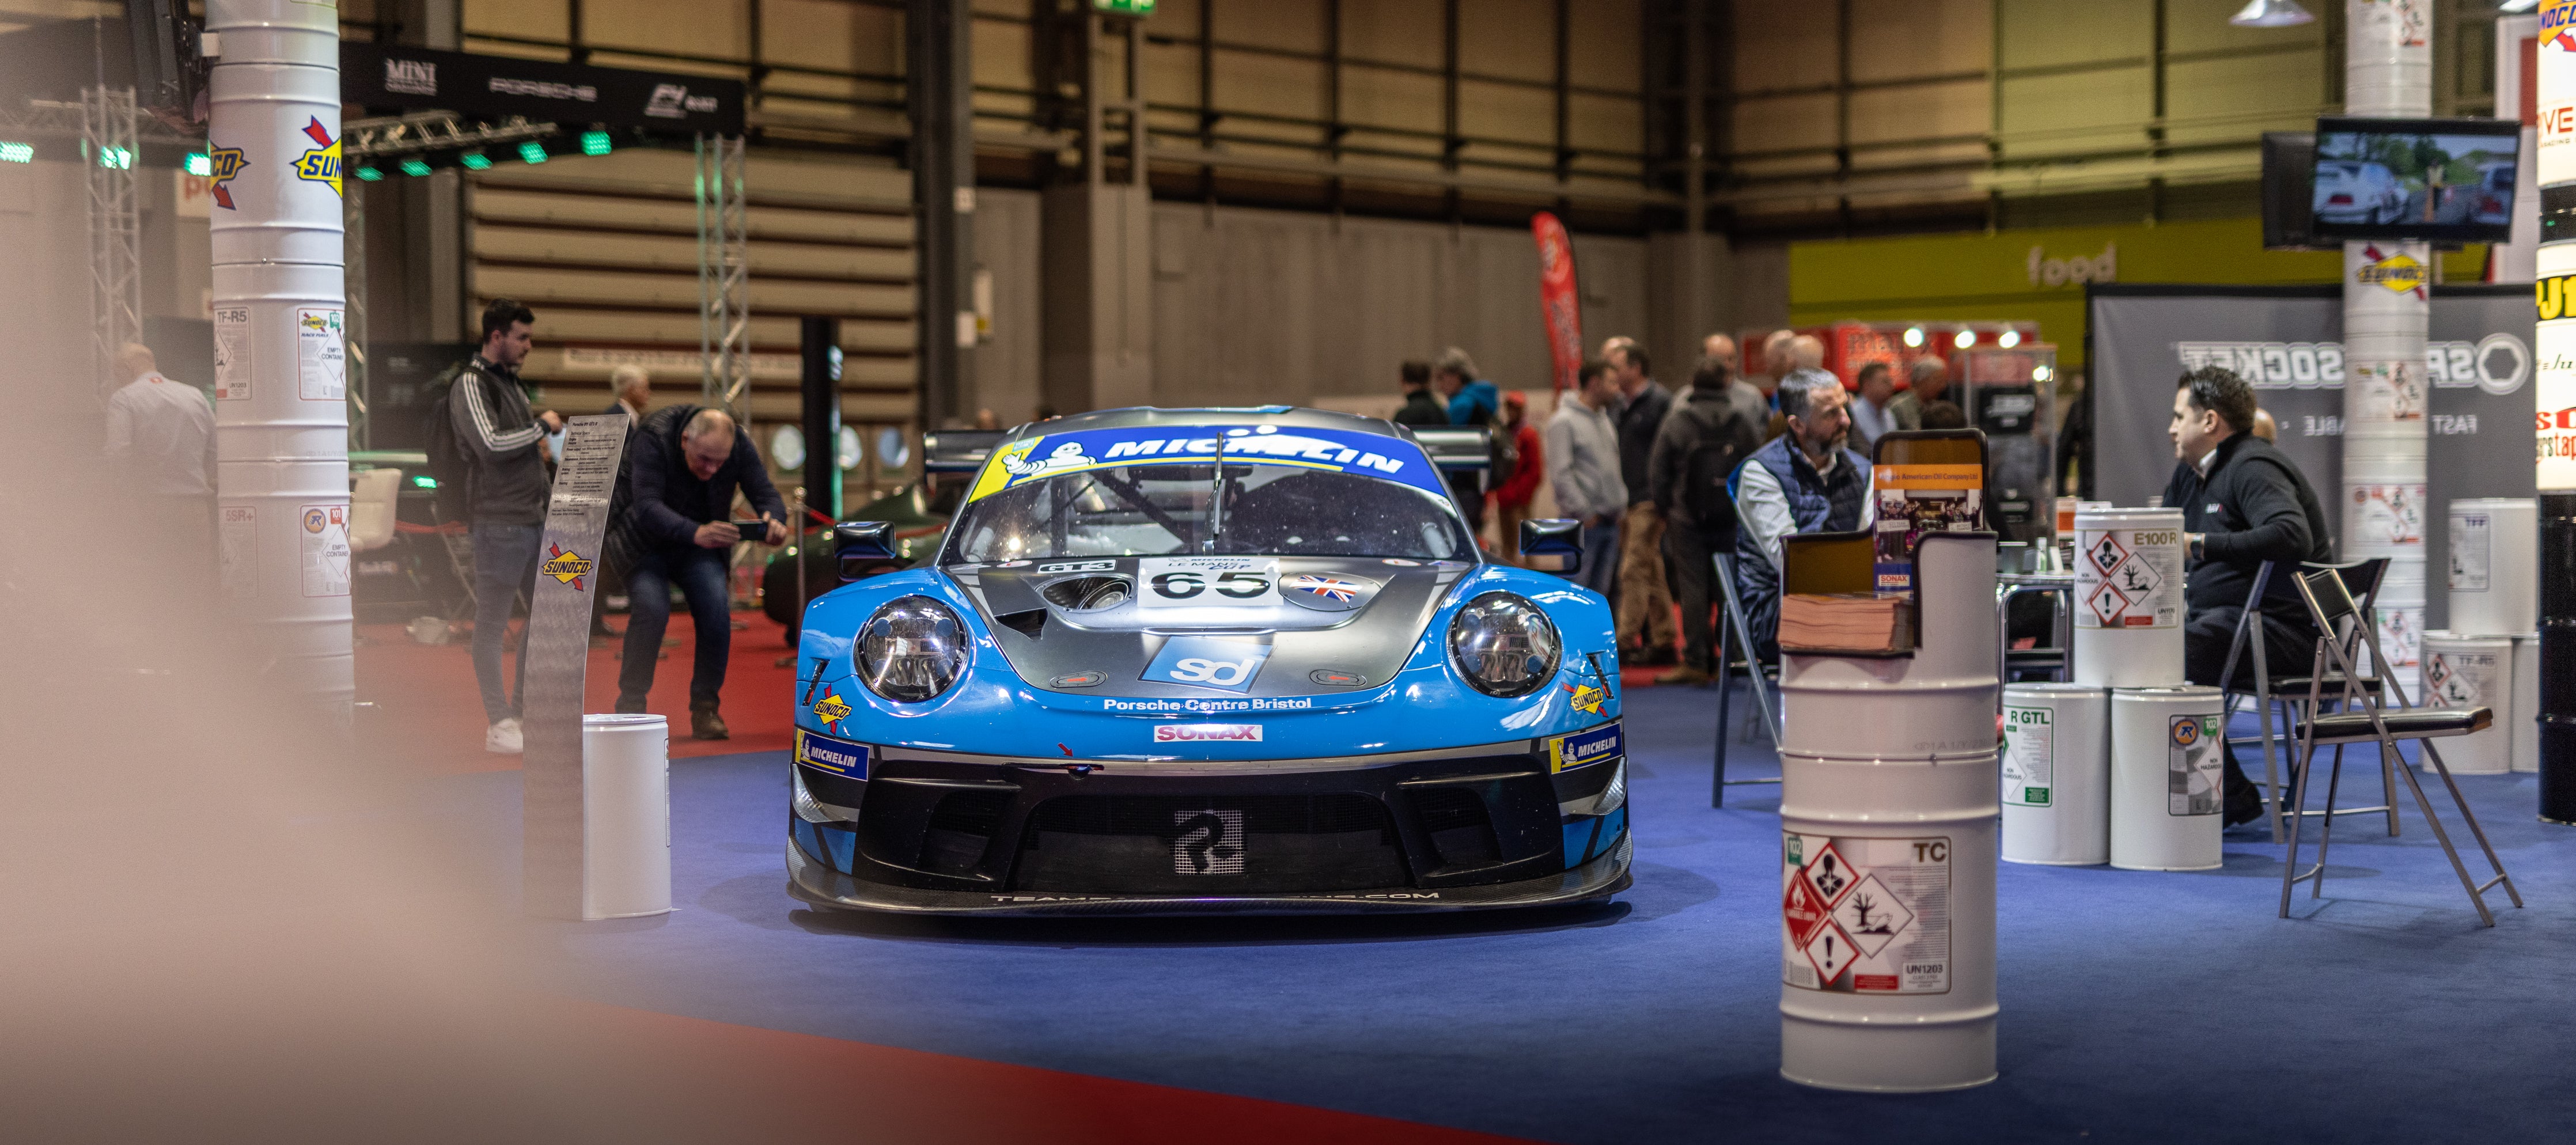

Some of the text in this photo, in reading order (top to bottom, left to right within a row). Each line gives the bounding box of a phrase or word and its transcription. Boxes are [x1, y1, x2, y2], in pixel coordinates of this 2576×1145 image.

[2027, 241, 2116, 287] food
[217, 310, 247, 324] TF-R5
[331, 314, 339, 323] 102
[331, 509, 341, 518] 101
[2134, 532, 2176, 545] E100 R
[545, 560, 590, 574] SUNOCO
[1040, 562, 1115, 572] GT3
[1151, 571, 1271, 600] 65
[1104, 698, 1312, 710] Porsche Centre Bristol
[1573, 689, 1603, 709] SUNOCO
[816, 700, 851, 718] SUNOCO
[2011, 711, 2050, 724] R GTL
[2206, 720, 2217, 729] 102
[1157, 725, 1257, 740] SONAX
[1577, 736, 1616, 757] MICHELIN
[810, 746, 857, 767] MICHELIN
[1789, 840, 1802, 855] 102
[1914, 842, 1947, 863] TC
[1907, 964, 1943, 974] UN1203
